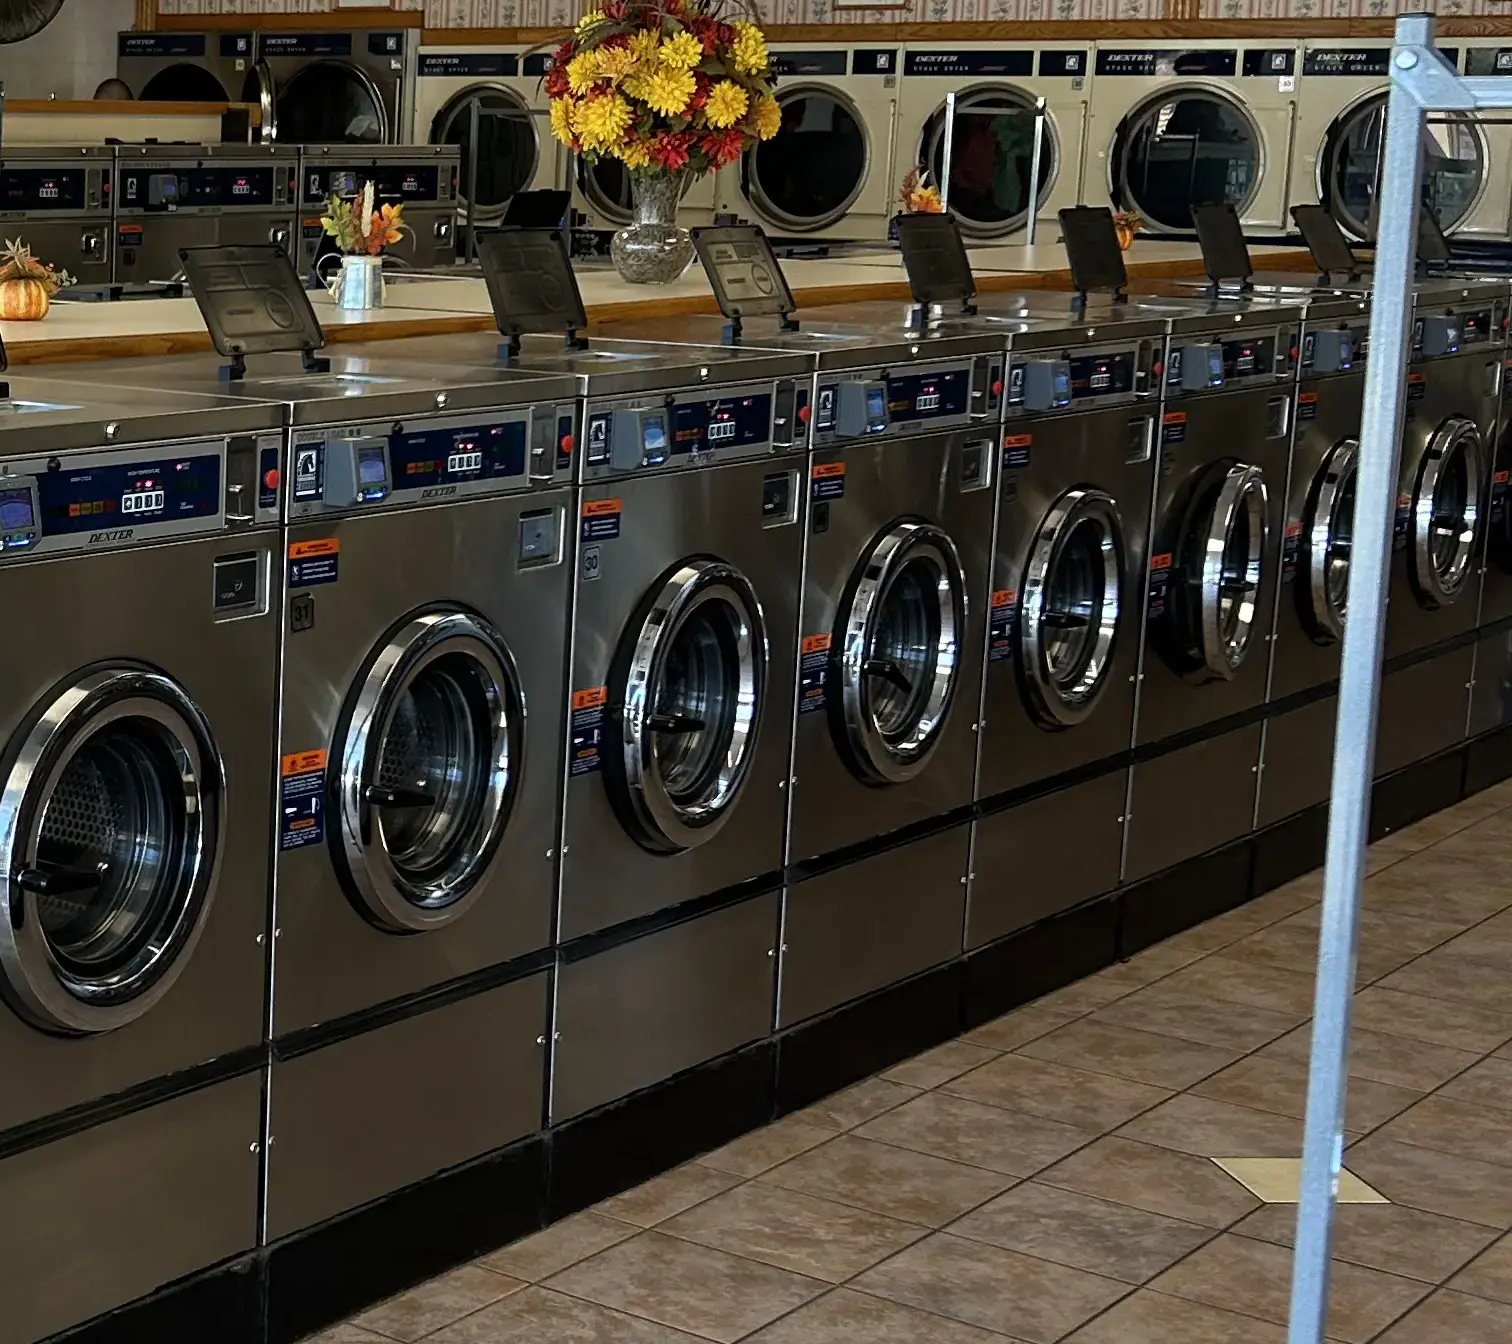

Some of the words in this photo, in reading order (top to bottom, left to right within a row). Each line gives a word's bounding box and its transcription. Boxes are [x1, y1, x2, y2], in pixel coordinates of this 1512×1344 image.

[87, 529, 134, 544] DEXTER
[585, 555, 598, 572] 30
[294, 603, 309, 622] 31
